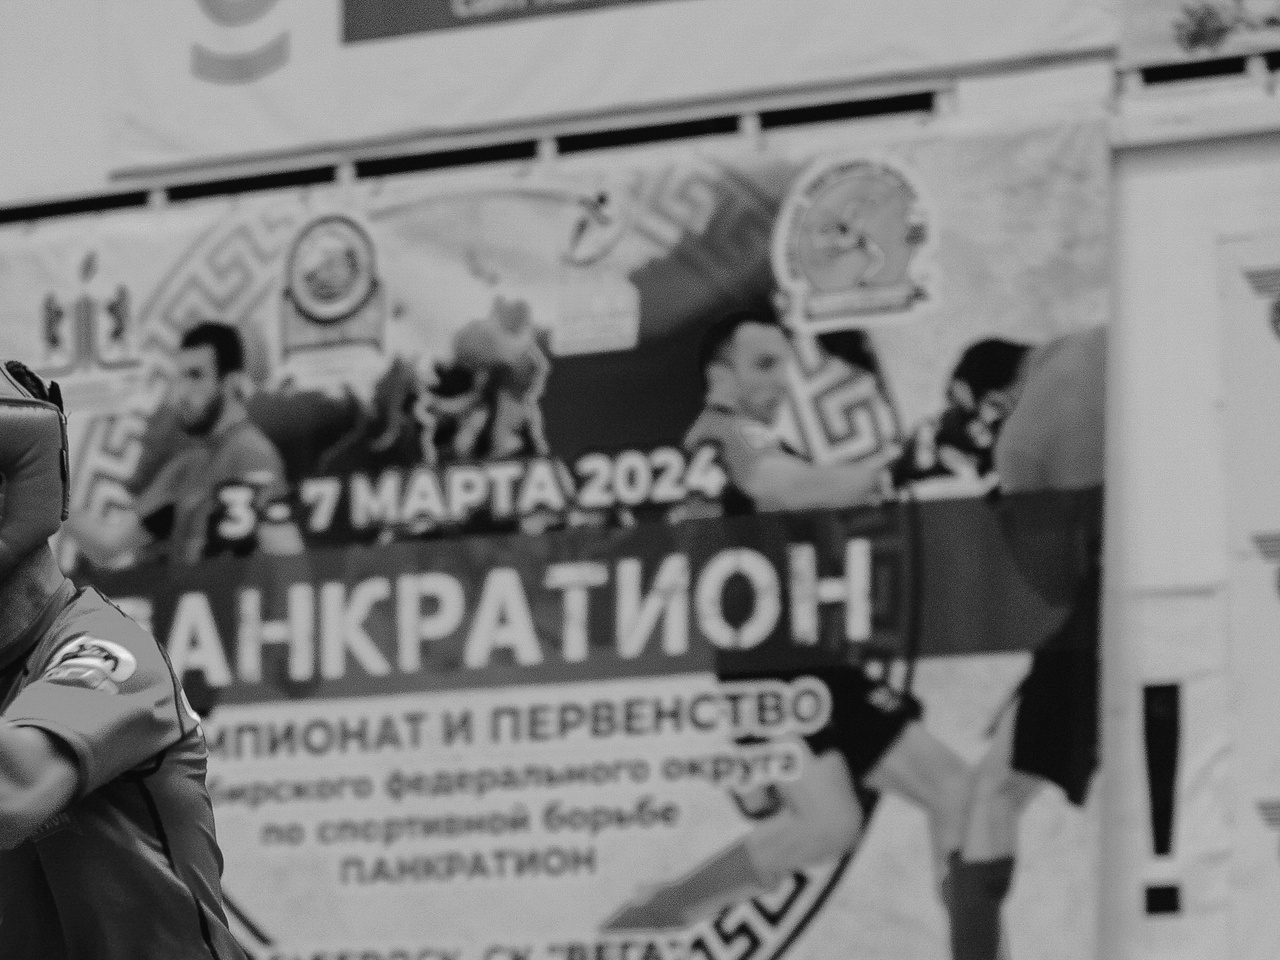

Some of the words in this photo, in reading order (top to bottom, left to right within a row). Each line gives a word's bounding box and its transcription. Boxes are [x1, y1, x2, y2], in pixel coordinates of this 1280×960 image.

[219, 485, 258, 541] 3
[300, 476, 342, 533] 7
[349, 457, 565, 529] МАРТА
[573, 445, 728, 510] 2024
[120, 538, 871, 687] АНКРАТИОН
[442, 708, 475, 747] И
[489, 686, 824, 744] ПЕРВЕНСТВО
[386, 759, 650, 805] федерального
[662, 752, 798, 788] округа
[260, 818, 305, 846] по
[319, 803, 530, 845] спортивной
[543, 795, 680, 836] борьбе
[340, 847, 597, 886] ПАНКРАТИОН
